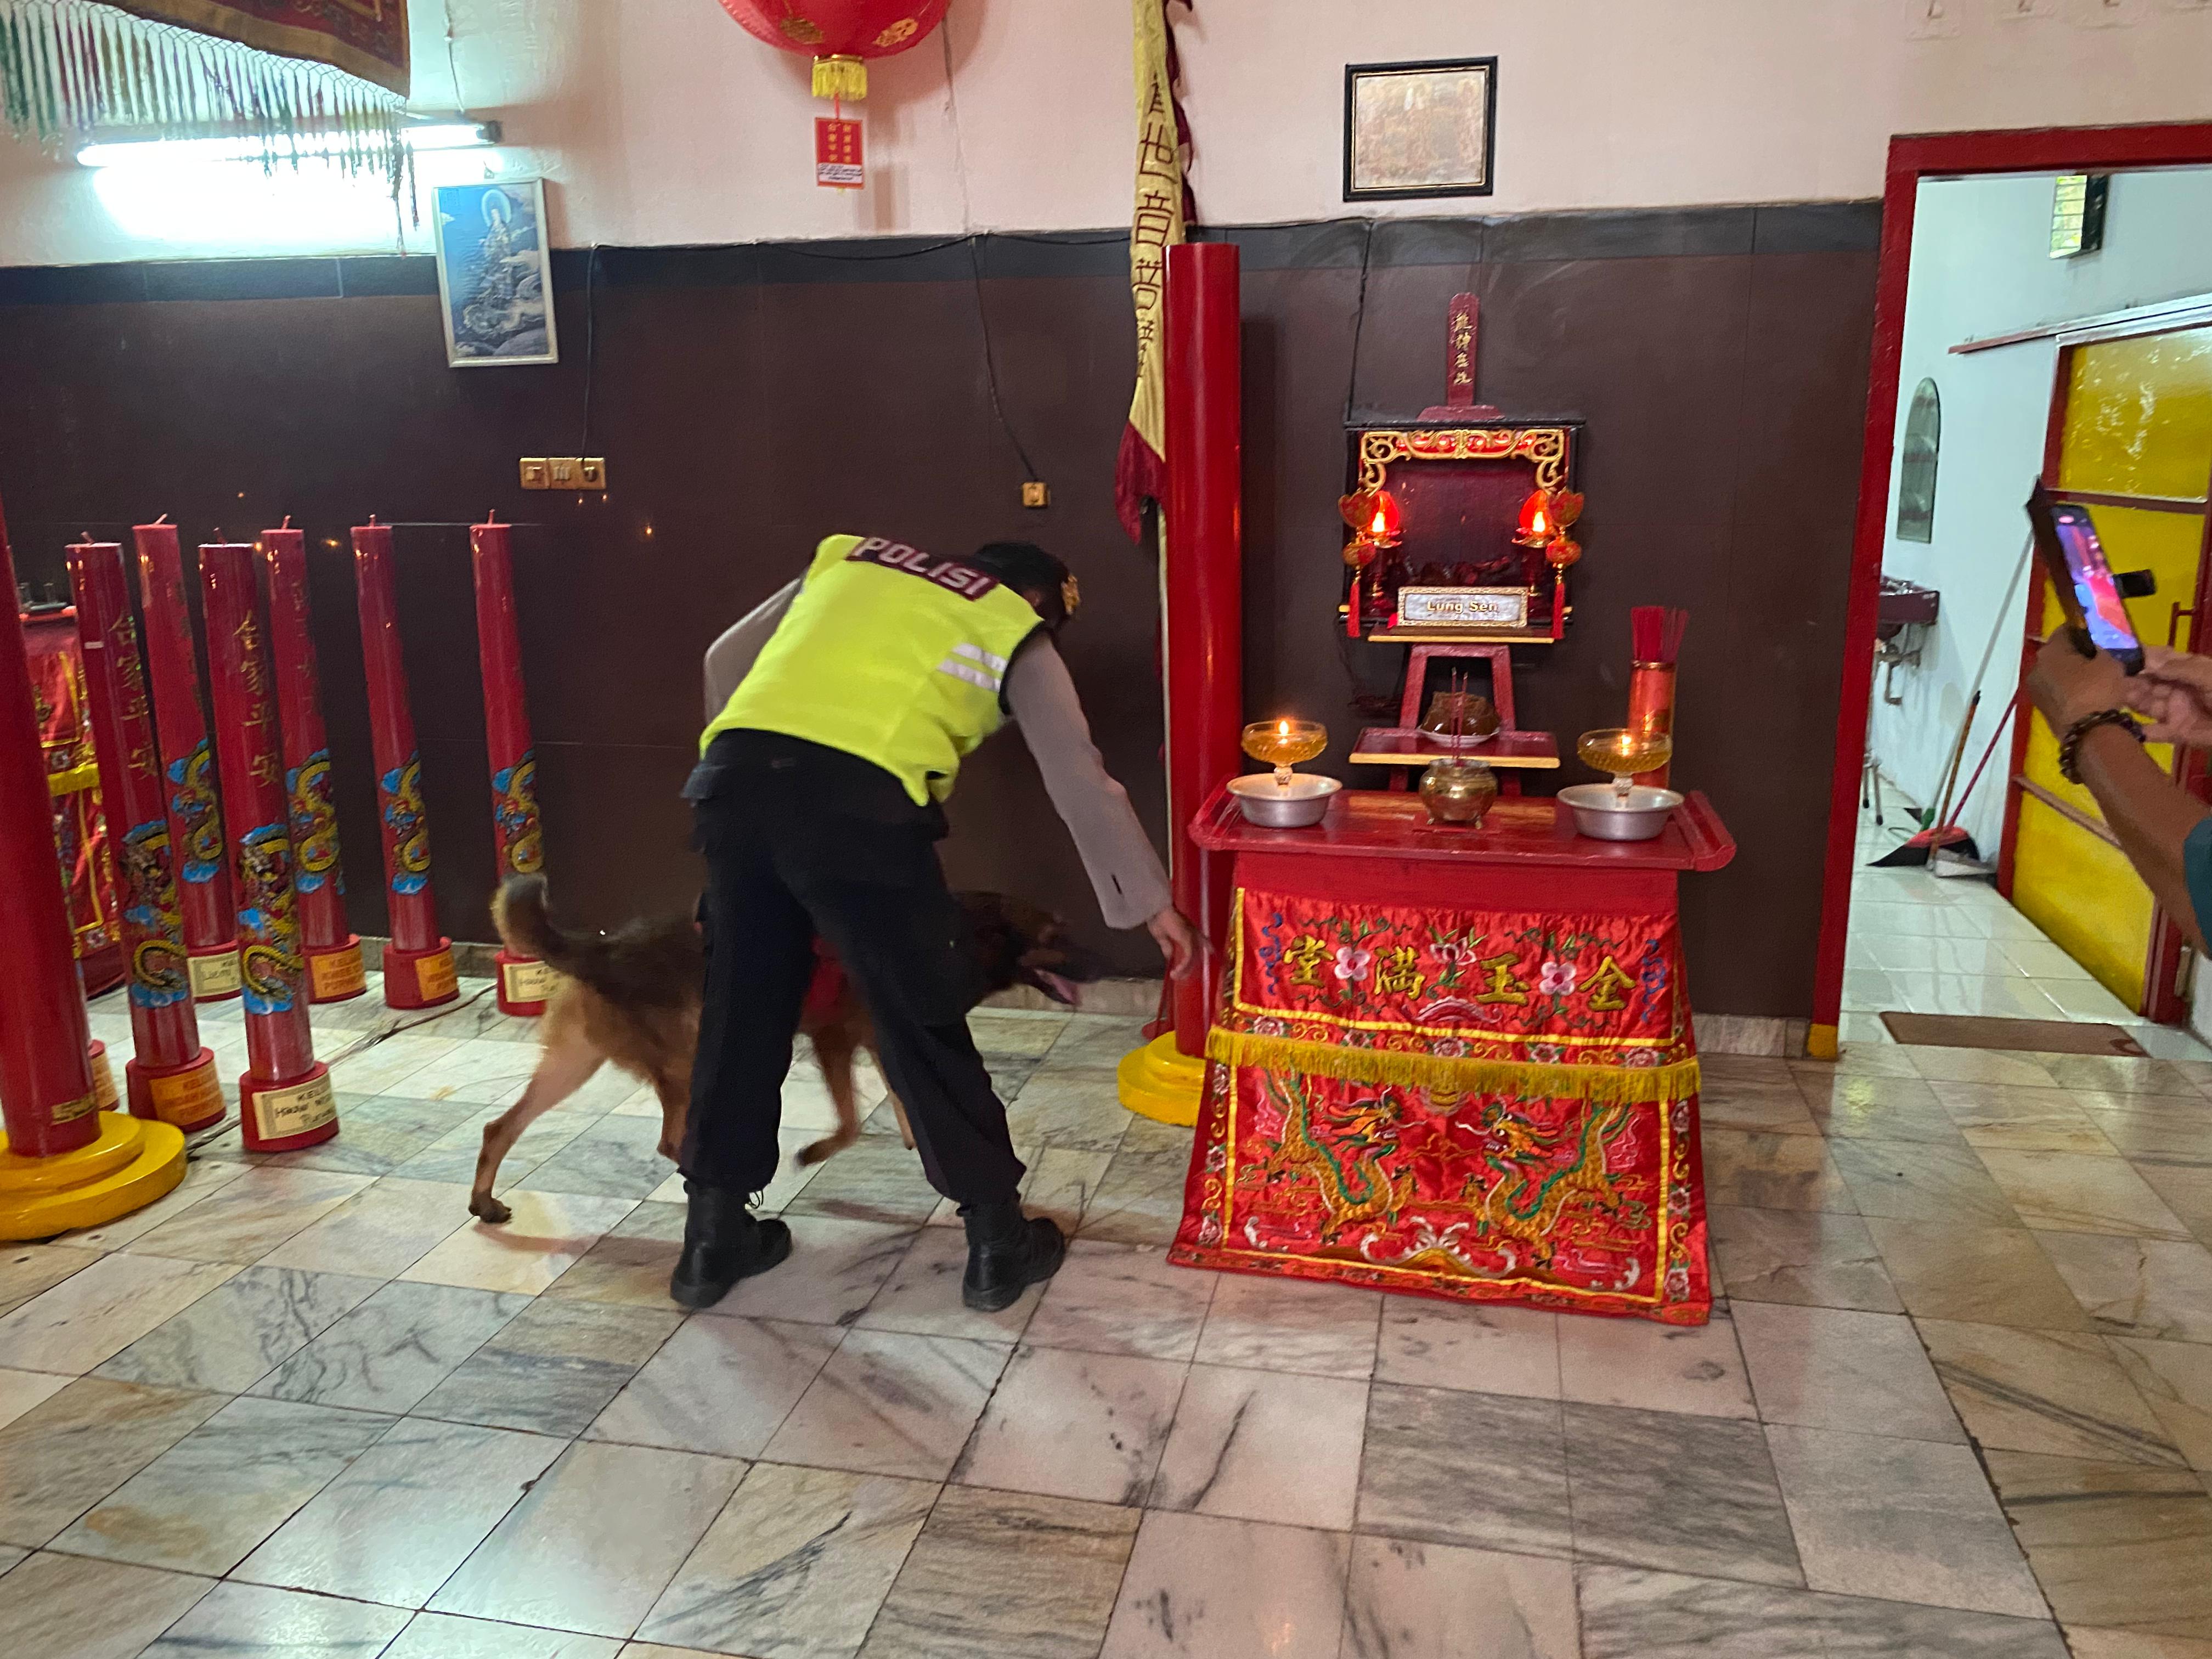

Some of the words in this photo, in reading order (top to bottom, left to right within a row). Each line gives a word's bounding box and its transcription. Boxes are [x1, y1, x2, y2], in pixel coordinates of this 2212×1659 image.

[852, 537, 990, 594] POLISI
[1427, 601, 1463, 614] Lung
[1469, 601, 1497, 612] Sen
